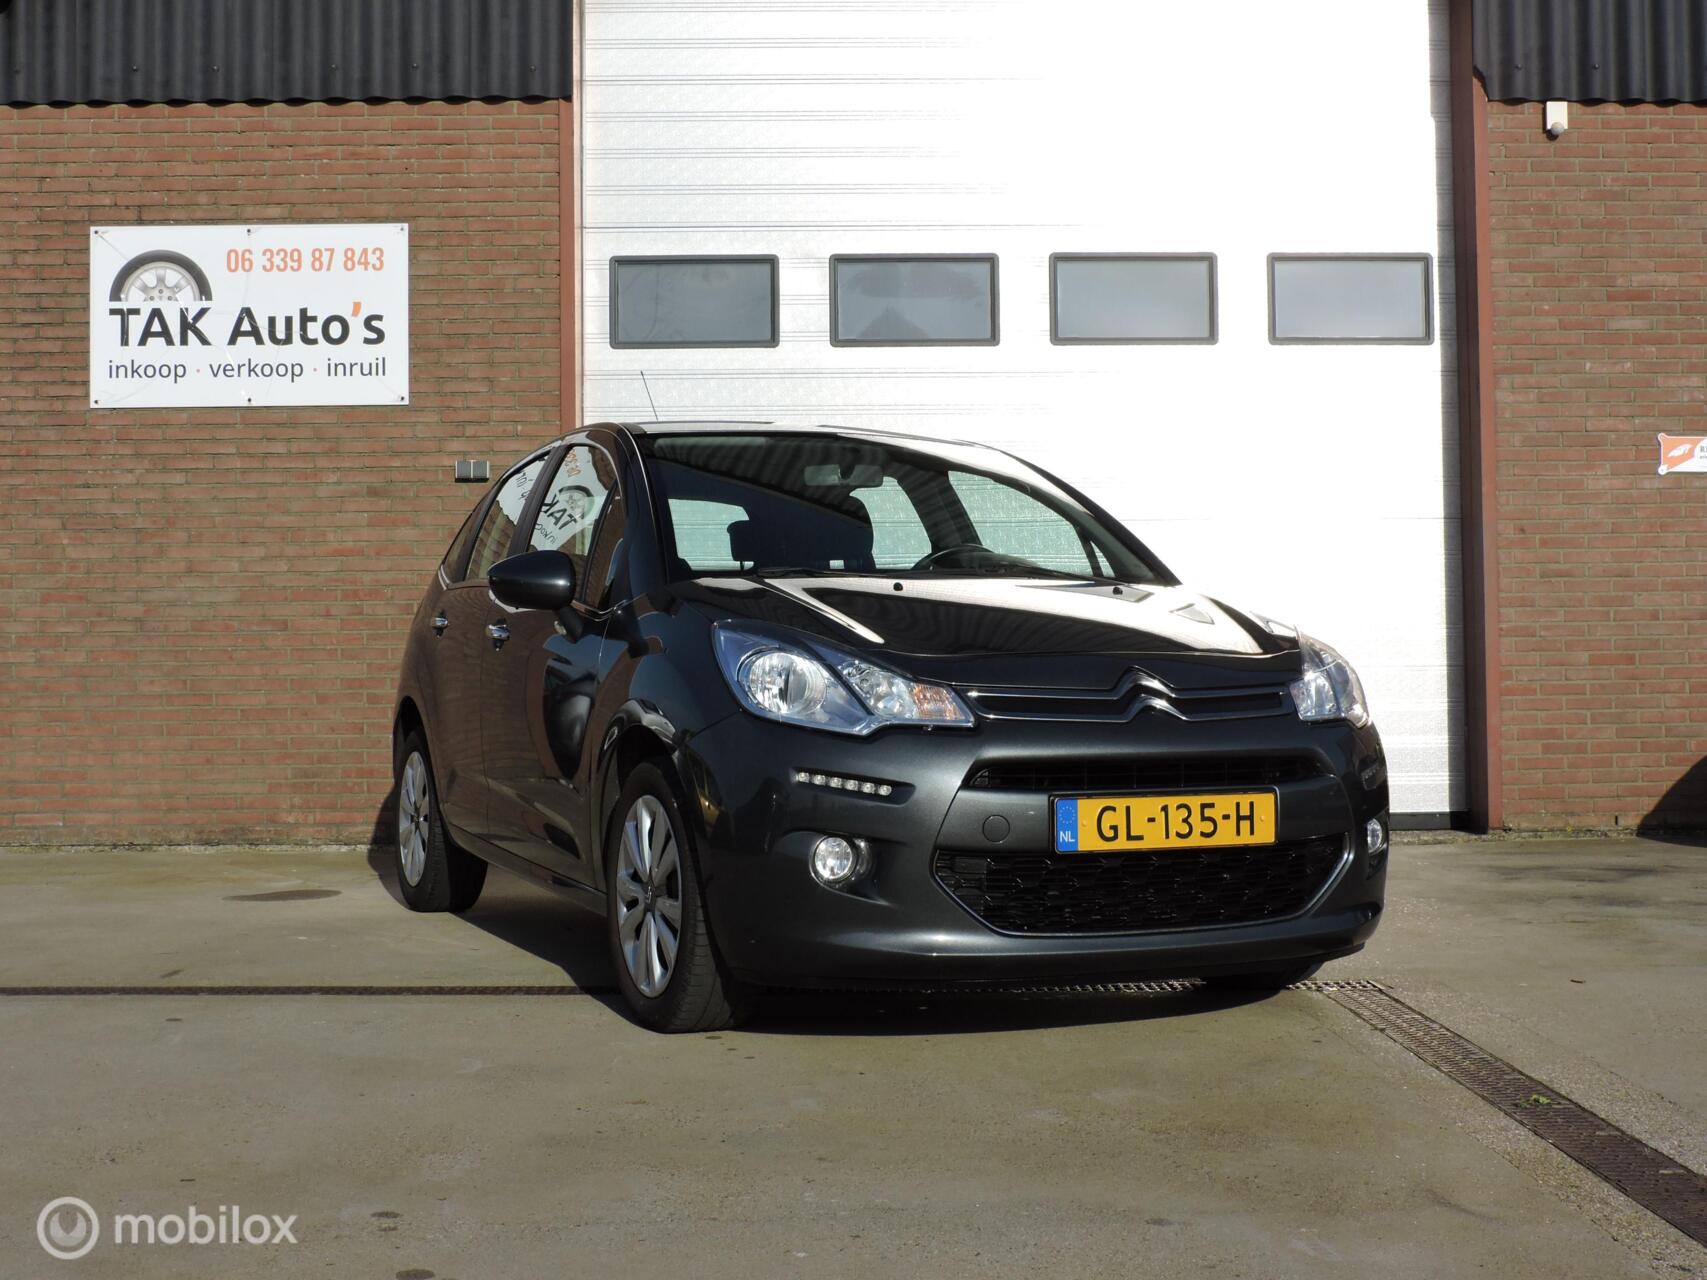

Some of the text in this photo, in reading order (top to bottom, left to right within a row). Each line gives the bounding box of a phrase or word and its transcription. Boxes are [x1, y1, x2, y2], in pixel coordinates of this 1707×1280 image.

[226, 246, 385, 273] 06 339 87 843
[108, 301, 386, 347] TAK Auto's
[108, 357, 386, 384] inkoop verkoop inruil
[1096, 800, 1255, 843] GL-135-H
[1059, 830, 1076, 843] NL
